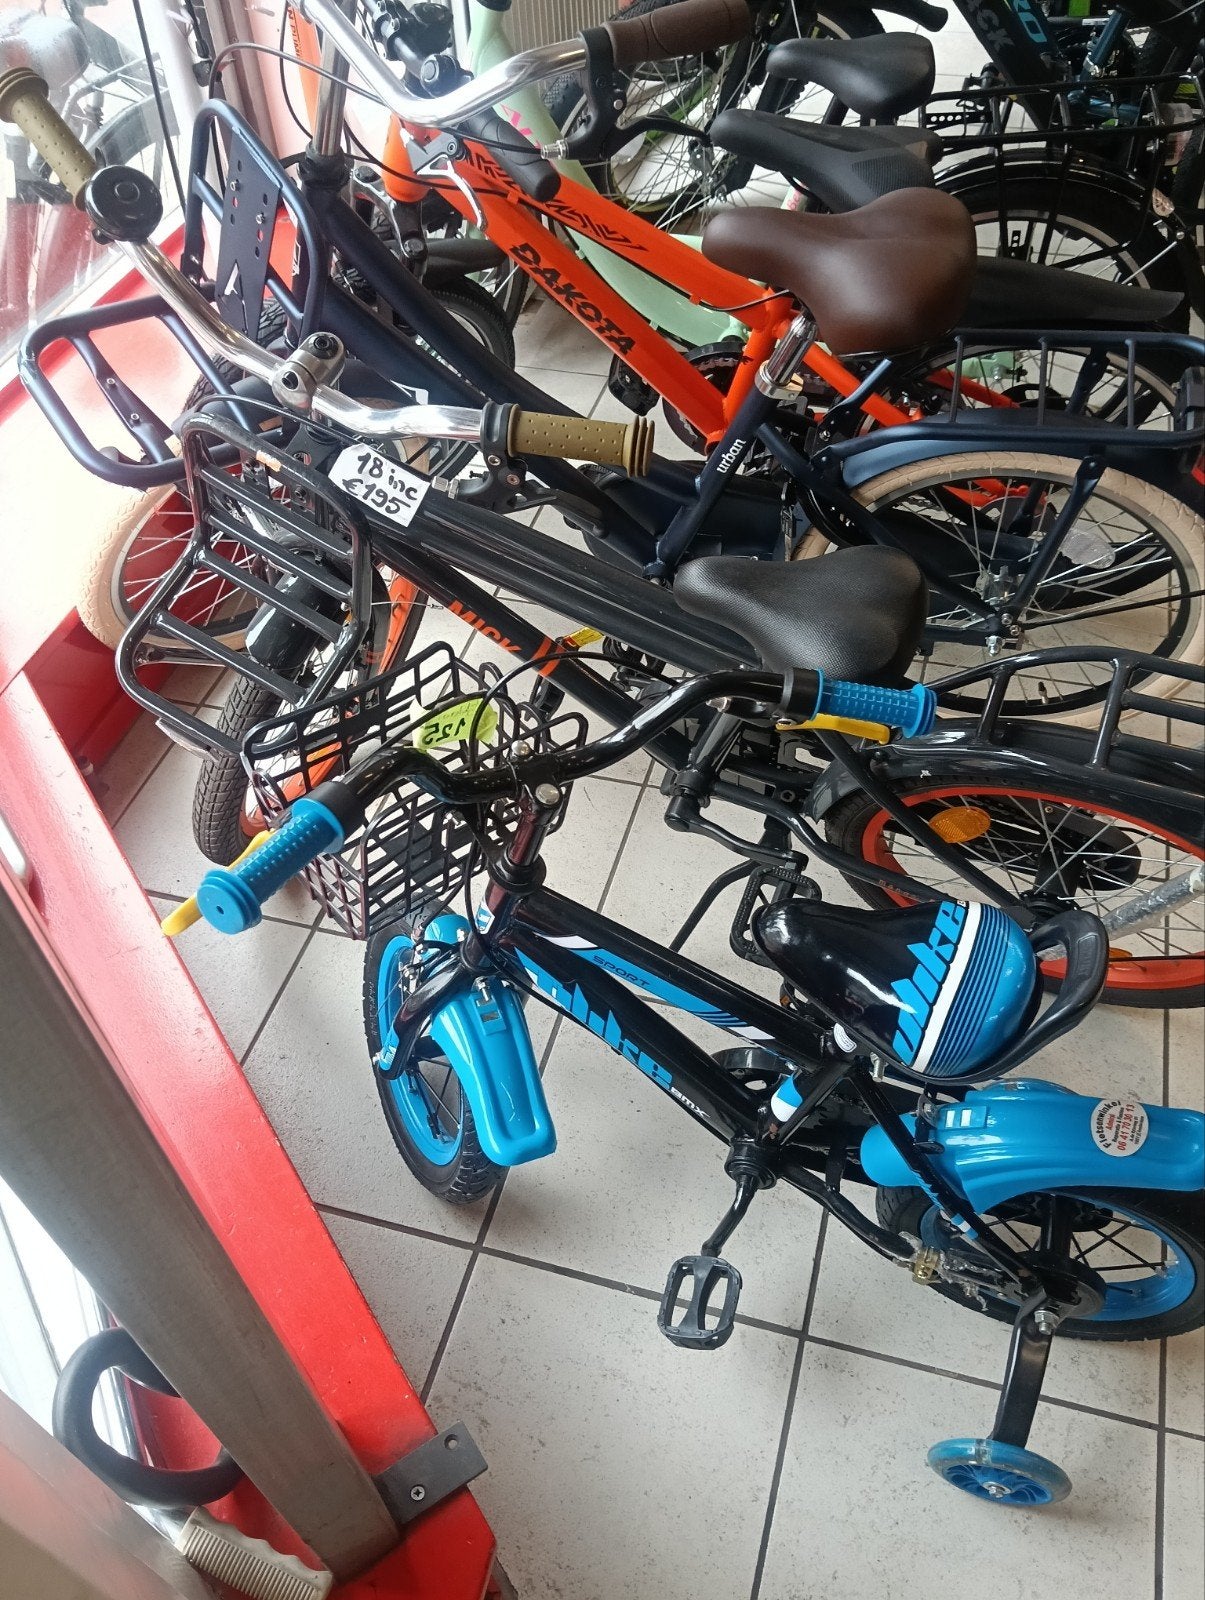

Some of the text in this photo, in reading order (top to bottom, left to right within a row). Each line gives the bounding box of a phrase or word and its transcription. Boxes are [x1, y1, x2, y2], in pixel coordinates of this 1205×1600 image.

[509, 242, 636, 355] DAKOTA
[357, 452, 418, 501] 18 inc
[717, 439, 747, 474] urban
[342, 478, 412, 514] €195
[448, 600, 522, 652] MICK
[592, 955, 652, 989] SPORT
